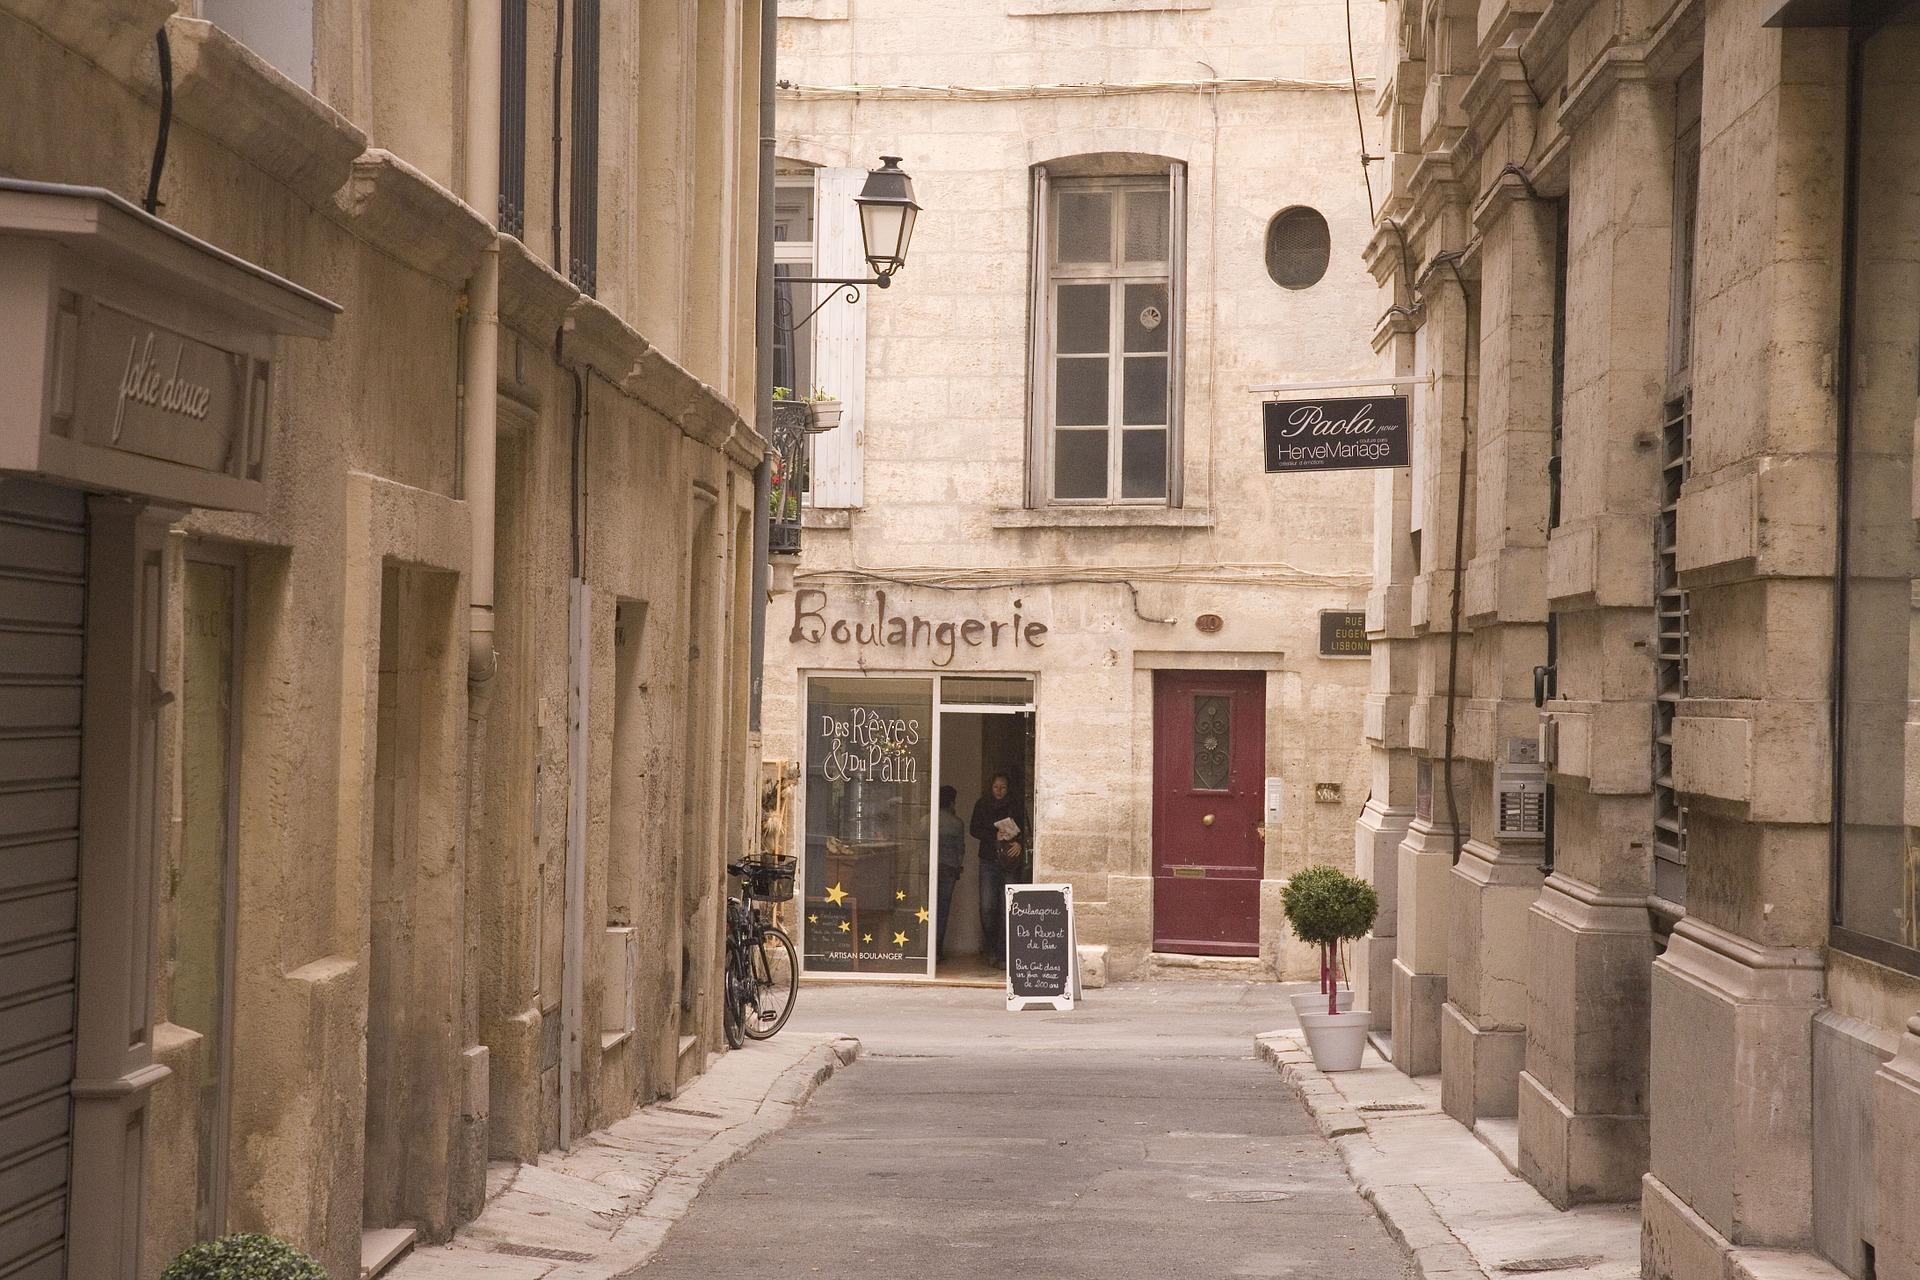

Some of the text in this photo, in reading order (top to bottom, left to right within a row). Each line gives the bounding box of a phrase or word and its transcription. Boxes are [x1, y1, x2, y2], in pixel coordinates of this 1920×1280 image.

[161, 342, 210, 419] douce
[1281, 403, 1399, 437] Paola pour
[1278, 440, 1390, 460] HerveMariage
[789, 590, 1048, 667] Boulangerie
[1345, 616, 1363, 626] RUE
[822, 707, 919, 747] Des Rêves
[824, 738, 917, 783] & Du Pain
[1017, 925, 1030, 938] Des
[1056, 928, 1065, 938] et
[1041, 938, 1057, 950] Pain
[829, 952, 903, 960] ARTISAN BOULANGER
